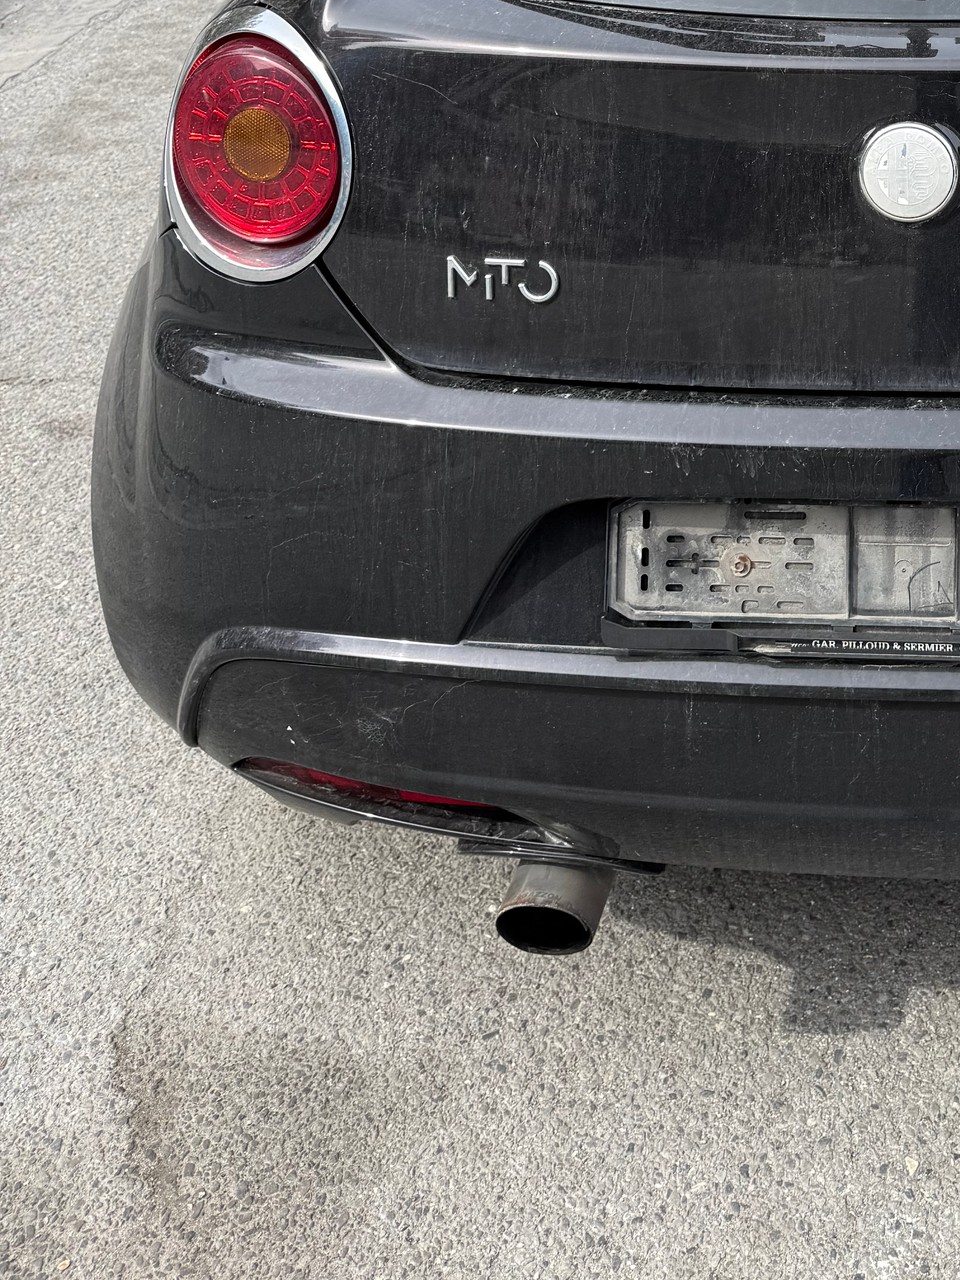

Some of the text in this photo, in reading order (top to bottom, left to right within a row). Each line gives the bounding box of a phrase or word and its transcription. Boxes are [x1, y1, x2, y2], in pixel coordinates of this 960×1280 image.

[842, 640, 890, 651] PILLOUD
[893, 641, 902, 651] &
[903, 642, 953, 652] SERMIER
